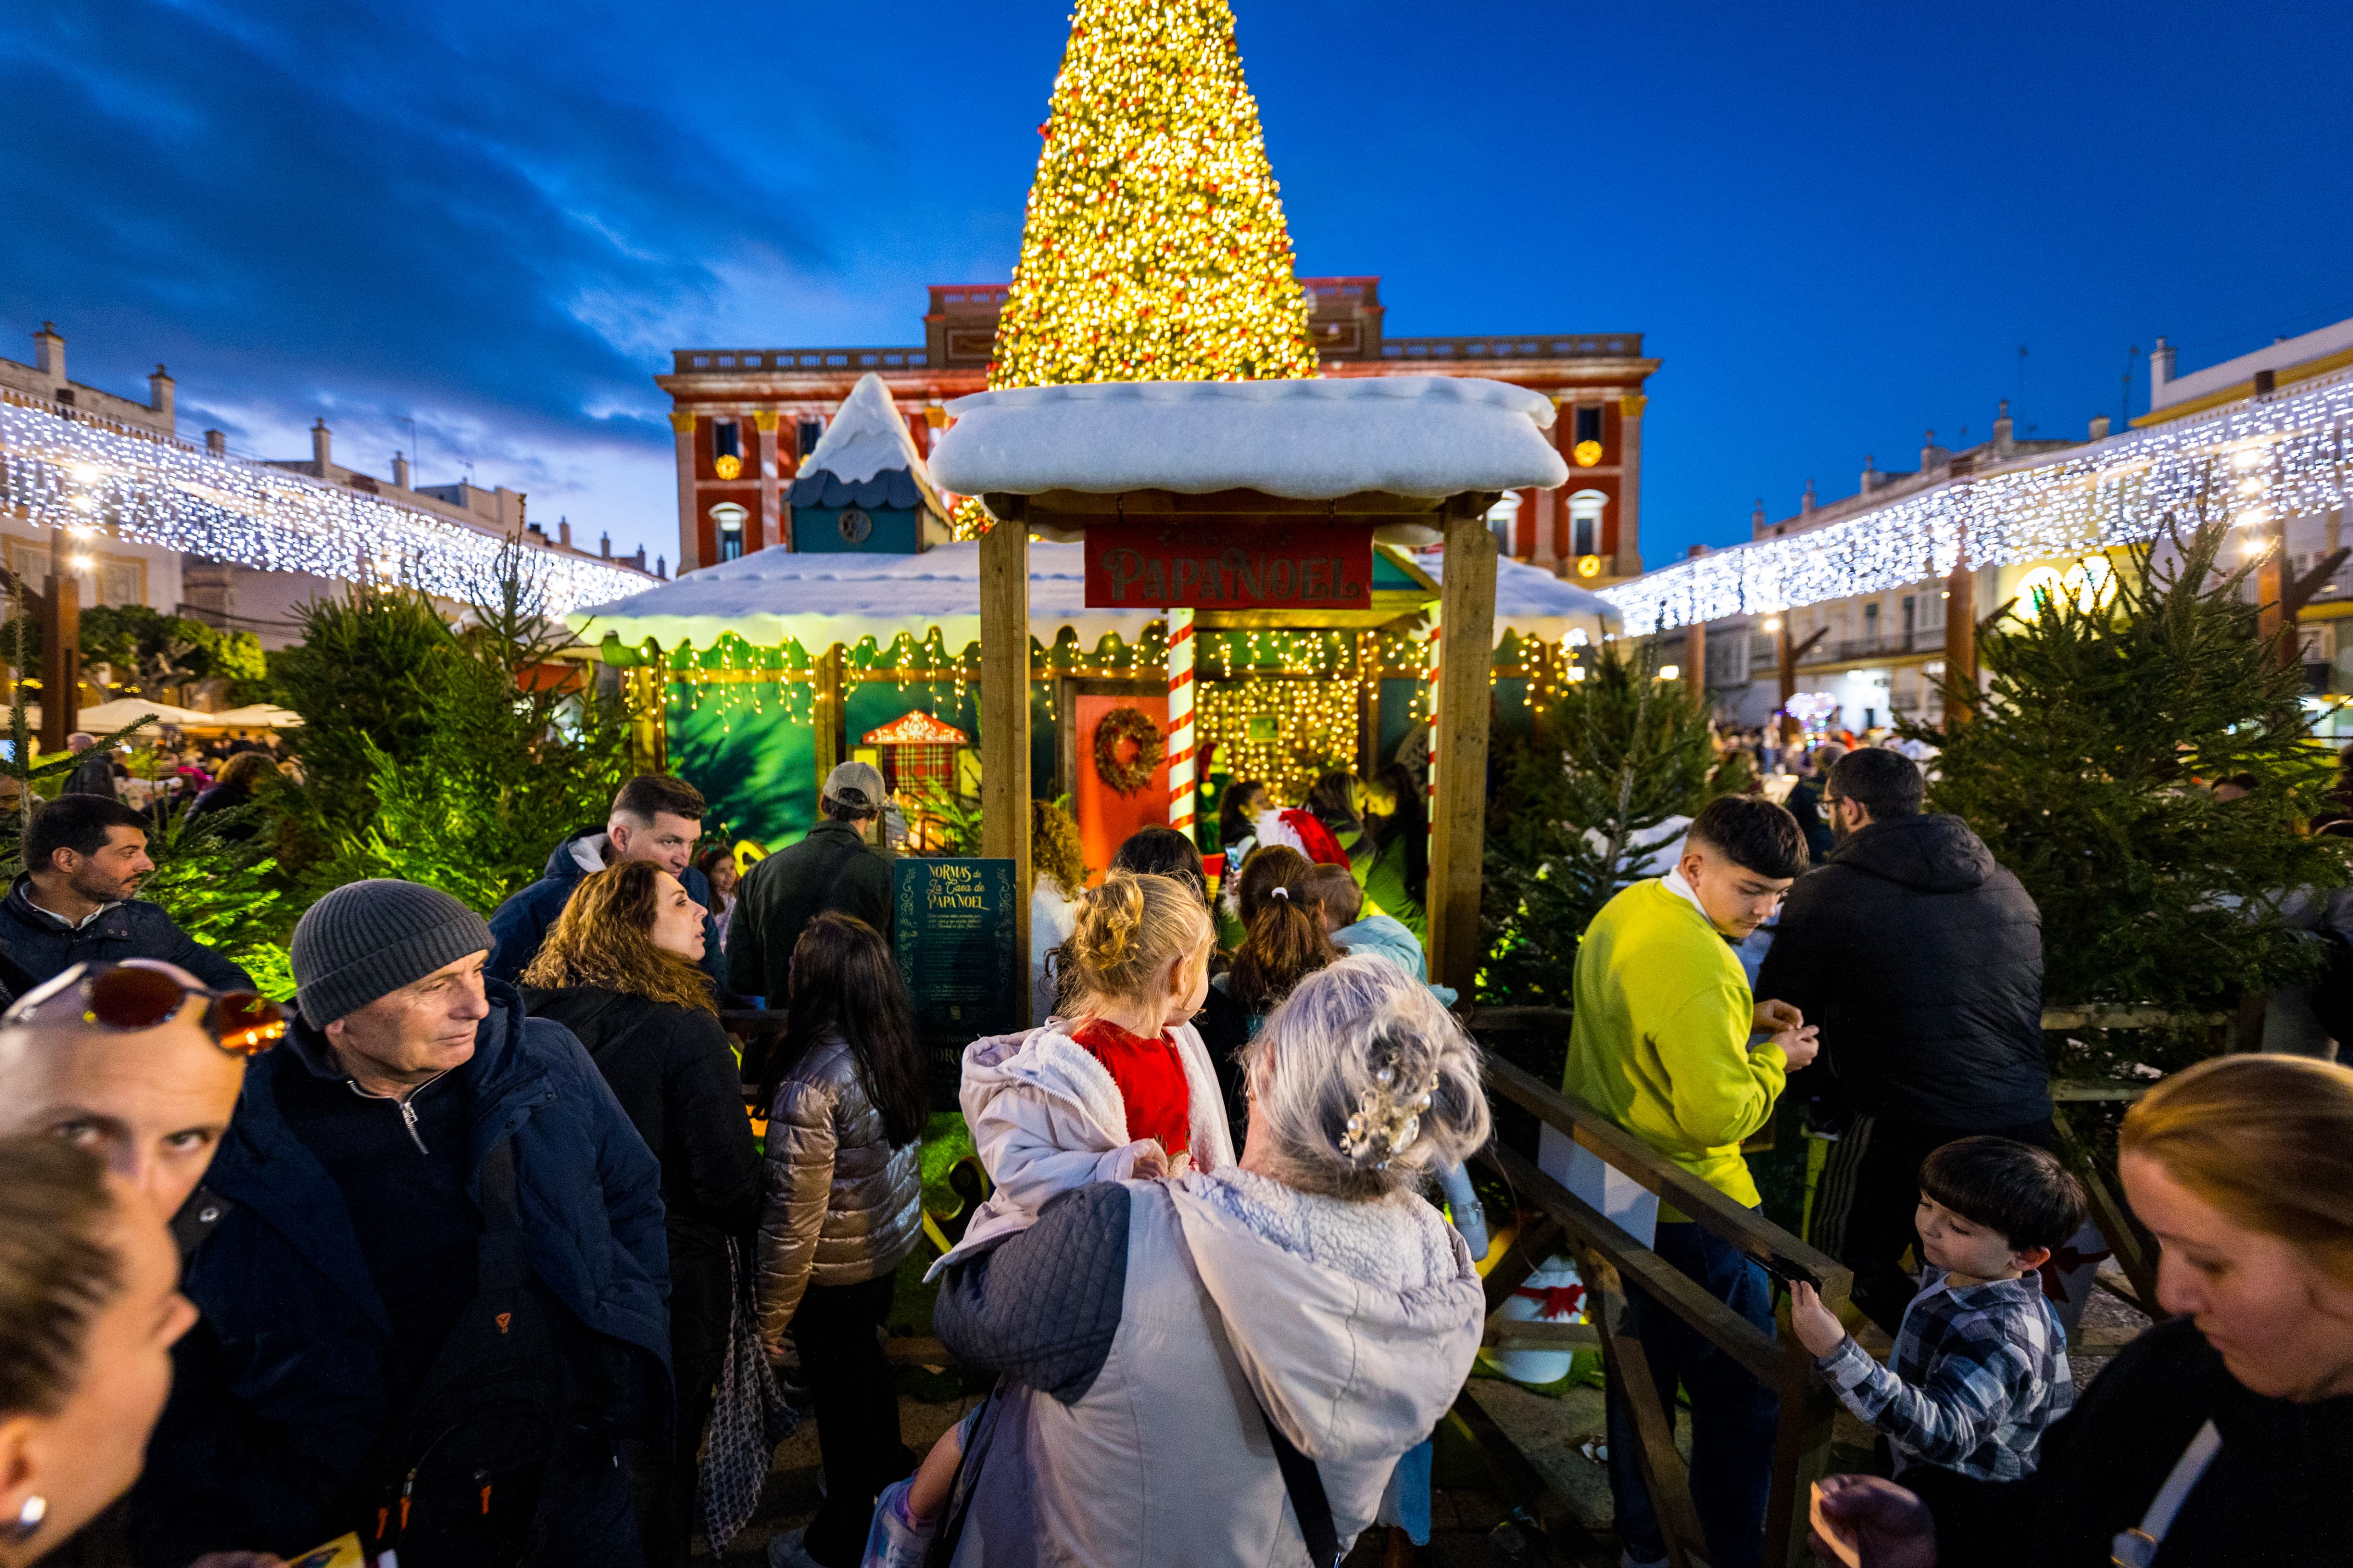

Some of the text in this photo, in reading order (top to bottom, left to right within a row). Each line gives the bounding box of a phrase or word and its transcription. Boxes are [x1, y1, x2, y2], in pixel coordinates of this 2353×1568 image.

[926, 863, 982, 882] NORMAS de
[926, 879, 985, 894] La Casa de
[927, 893, 990, 910] PAPA NOEL
